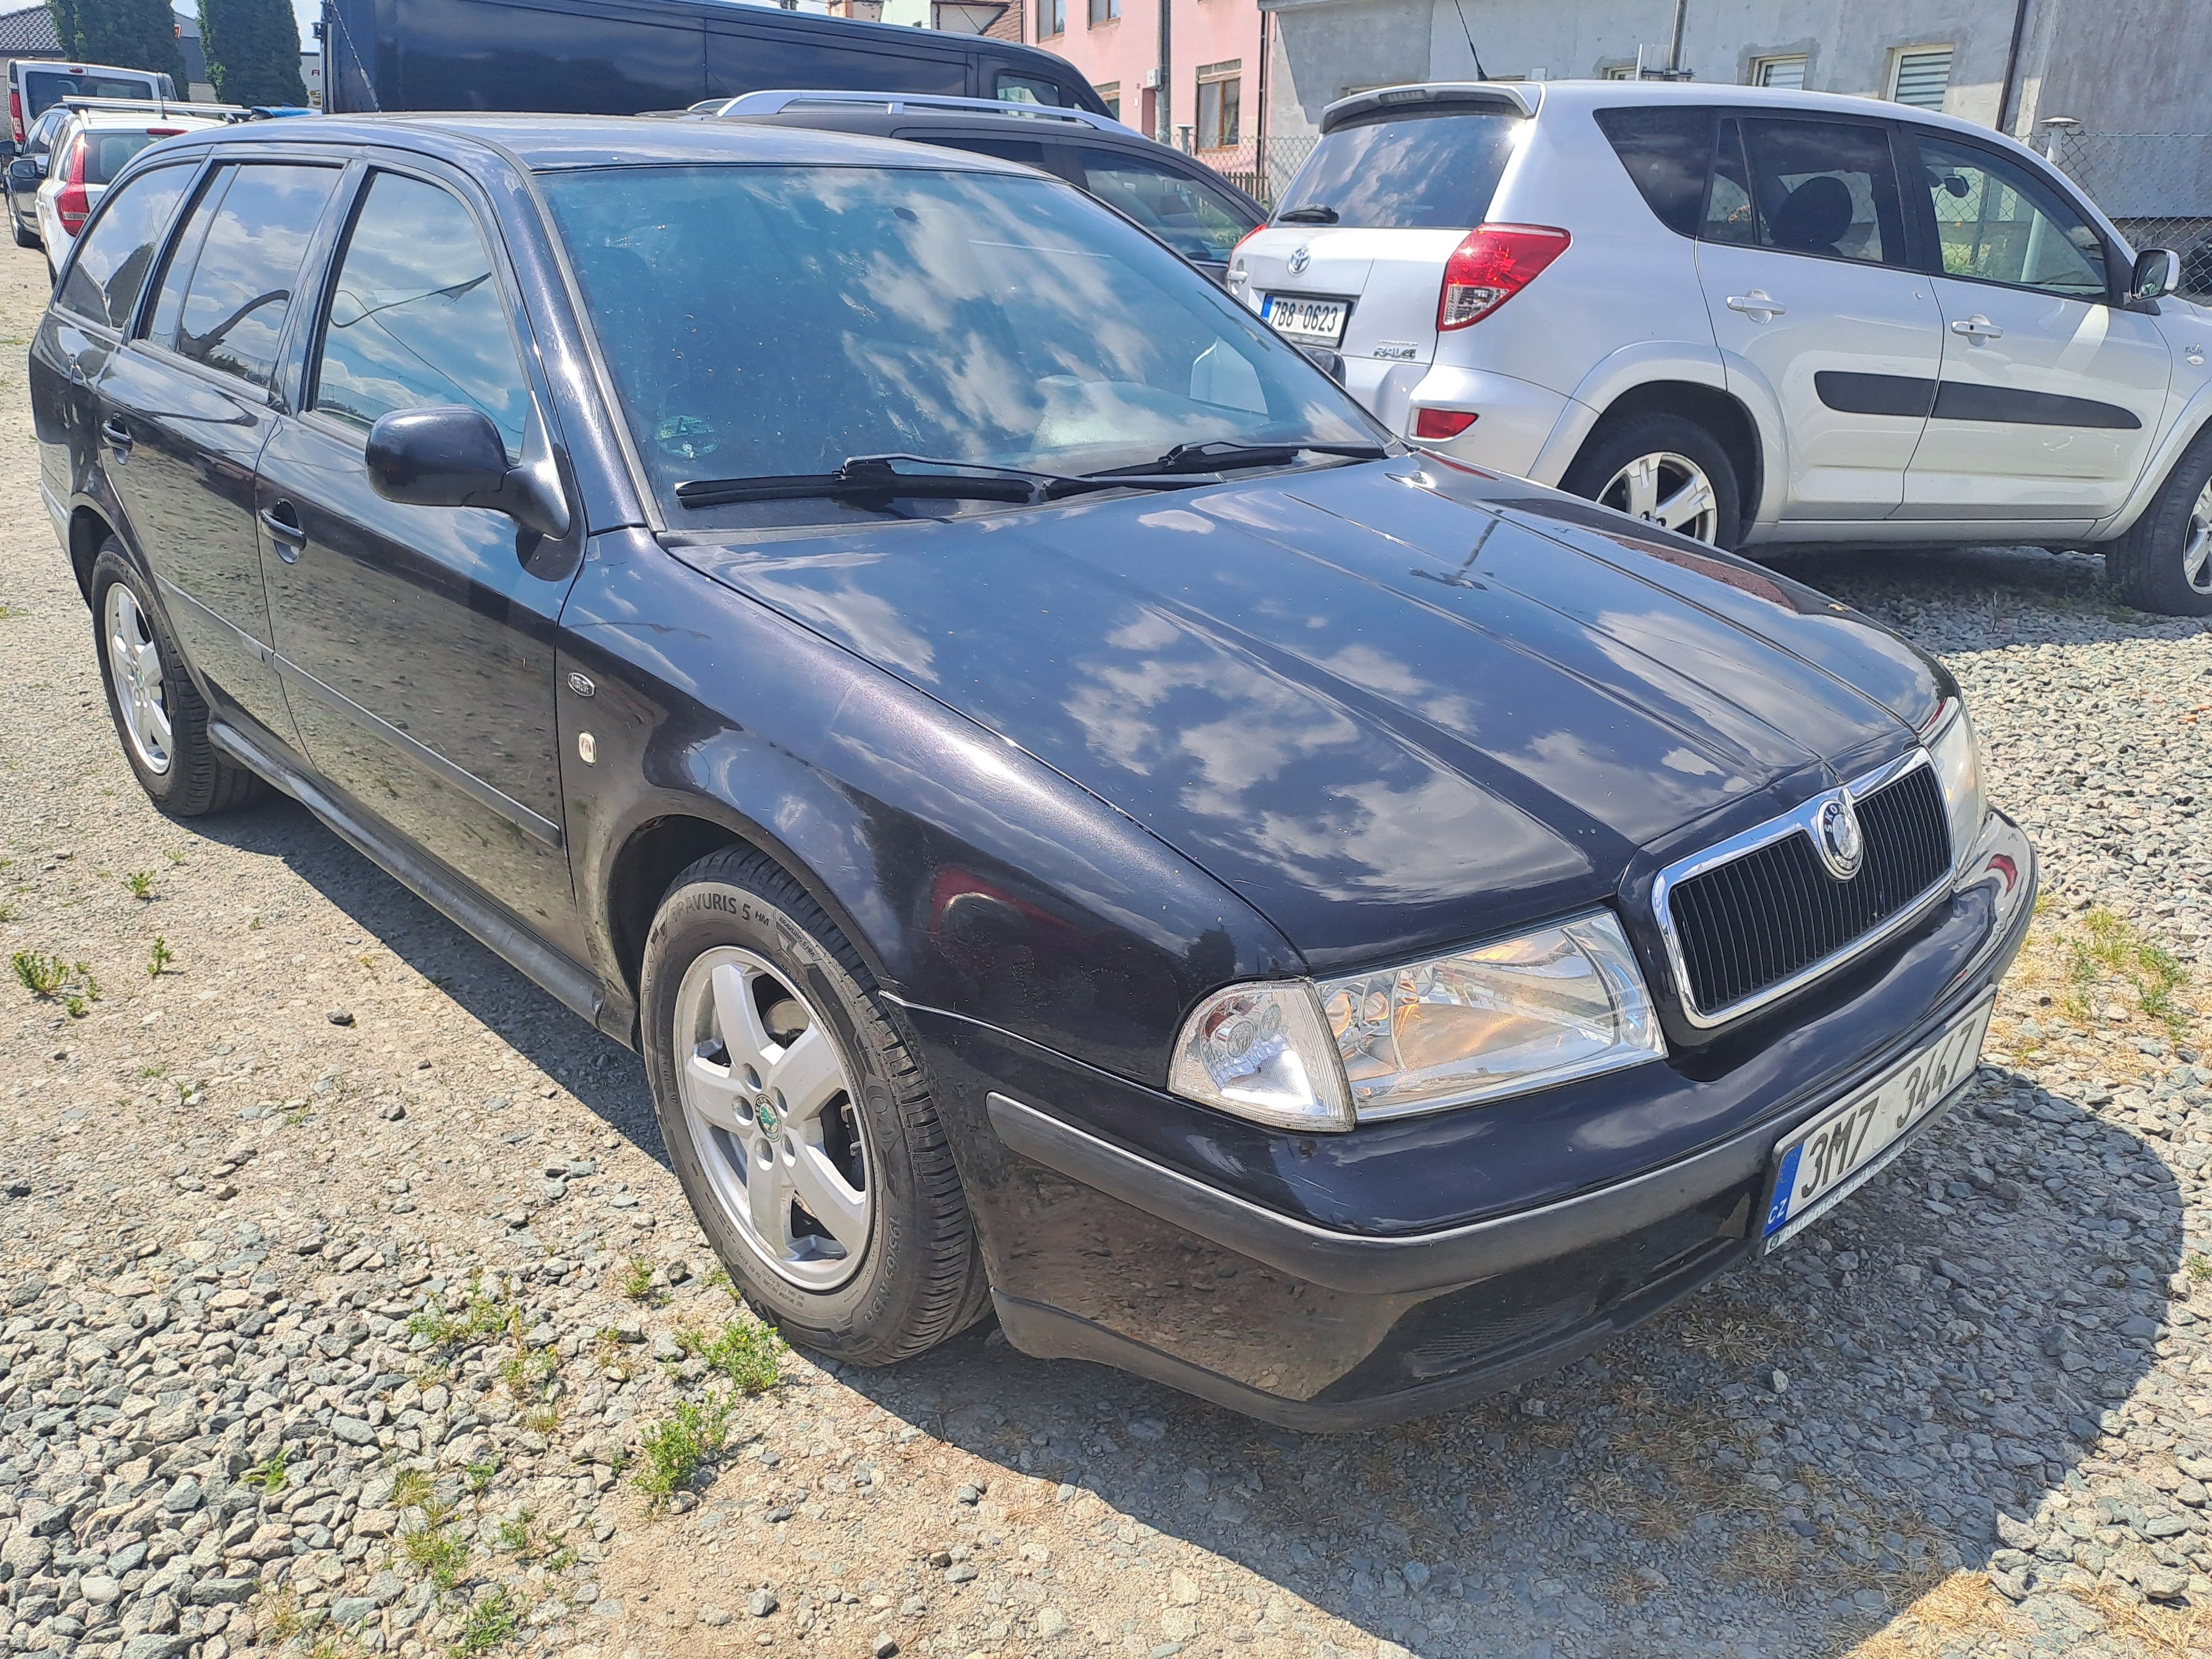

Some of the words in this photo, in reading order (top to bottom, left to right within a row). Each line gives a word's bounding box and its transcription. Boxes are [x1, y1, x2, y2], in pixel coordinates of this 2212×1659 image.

[1271, 301, 1296, 327] 7B8
[1303, 304, 1338, 332] 0623
[1373, 346, 1416, 360] RAV4
[742, 903, 752, 921] 5
[755, 910, 770, 927] HM
[1801, 1095, 1880, 1198] 3M7
[1896, 1018, 1976, 1129] 3447
[1768, 1197, 1788, 1224] CZ
